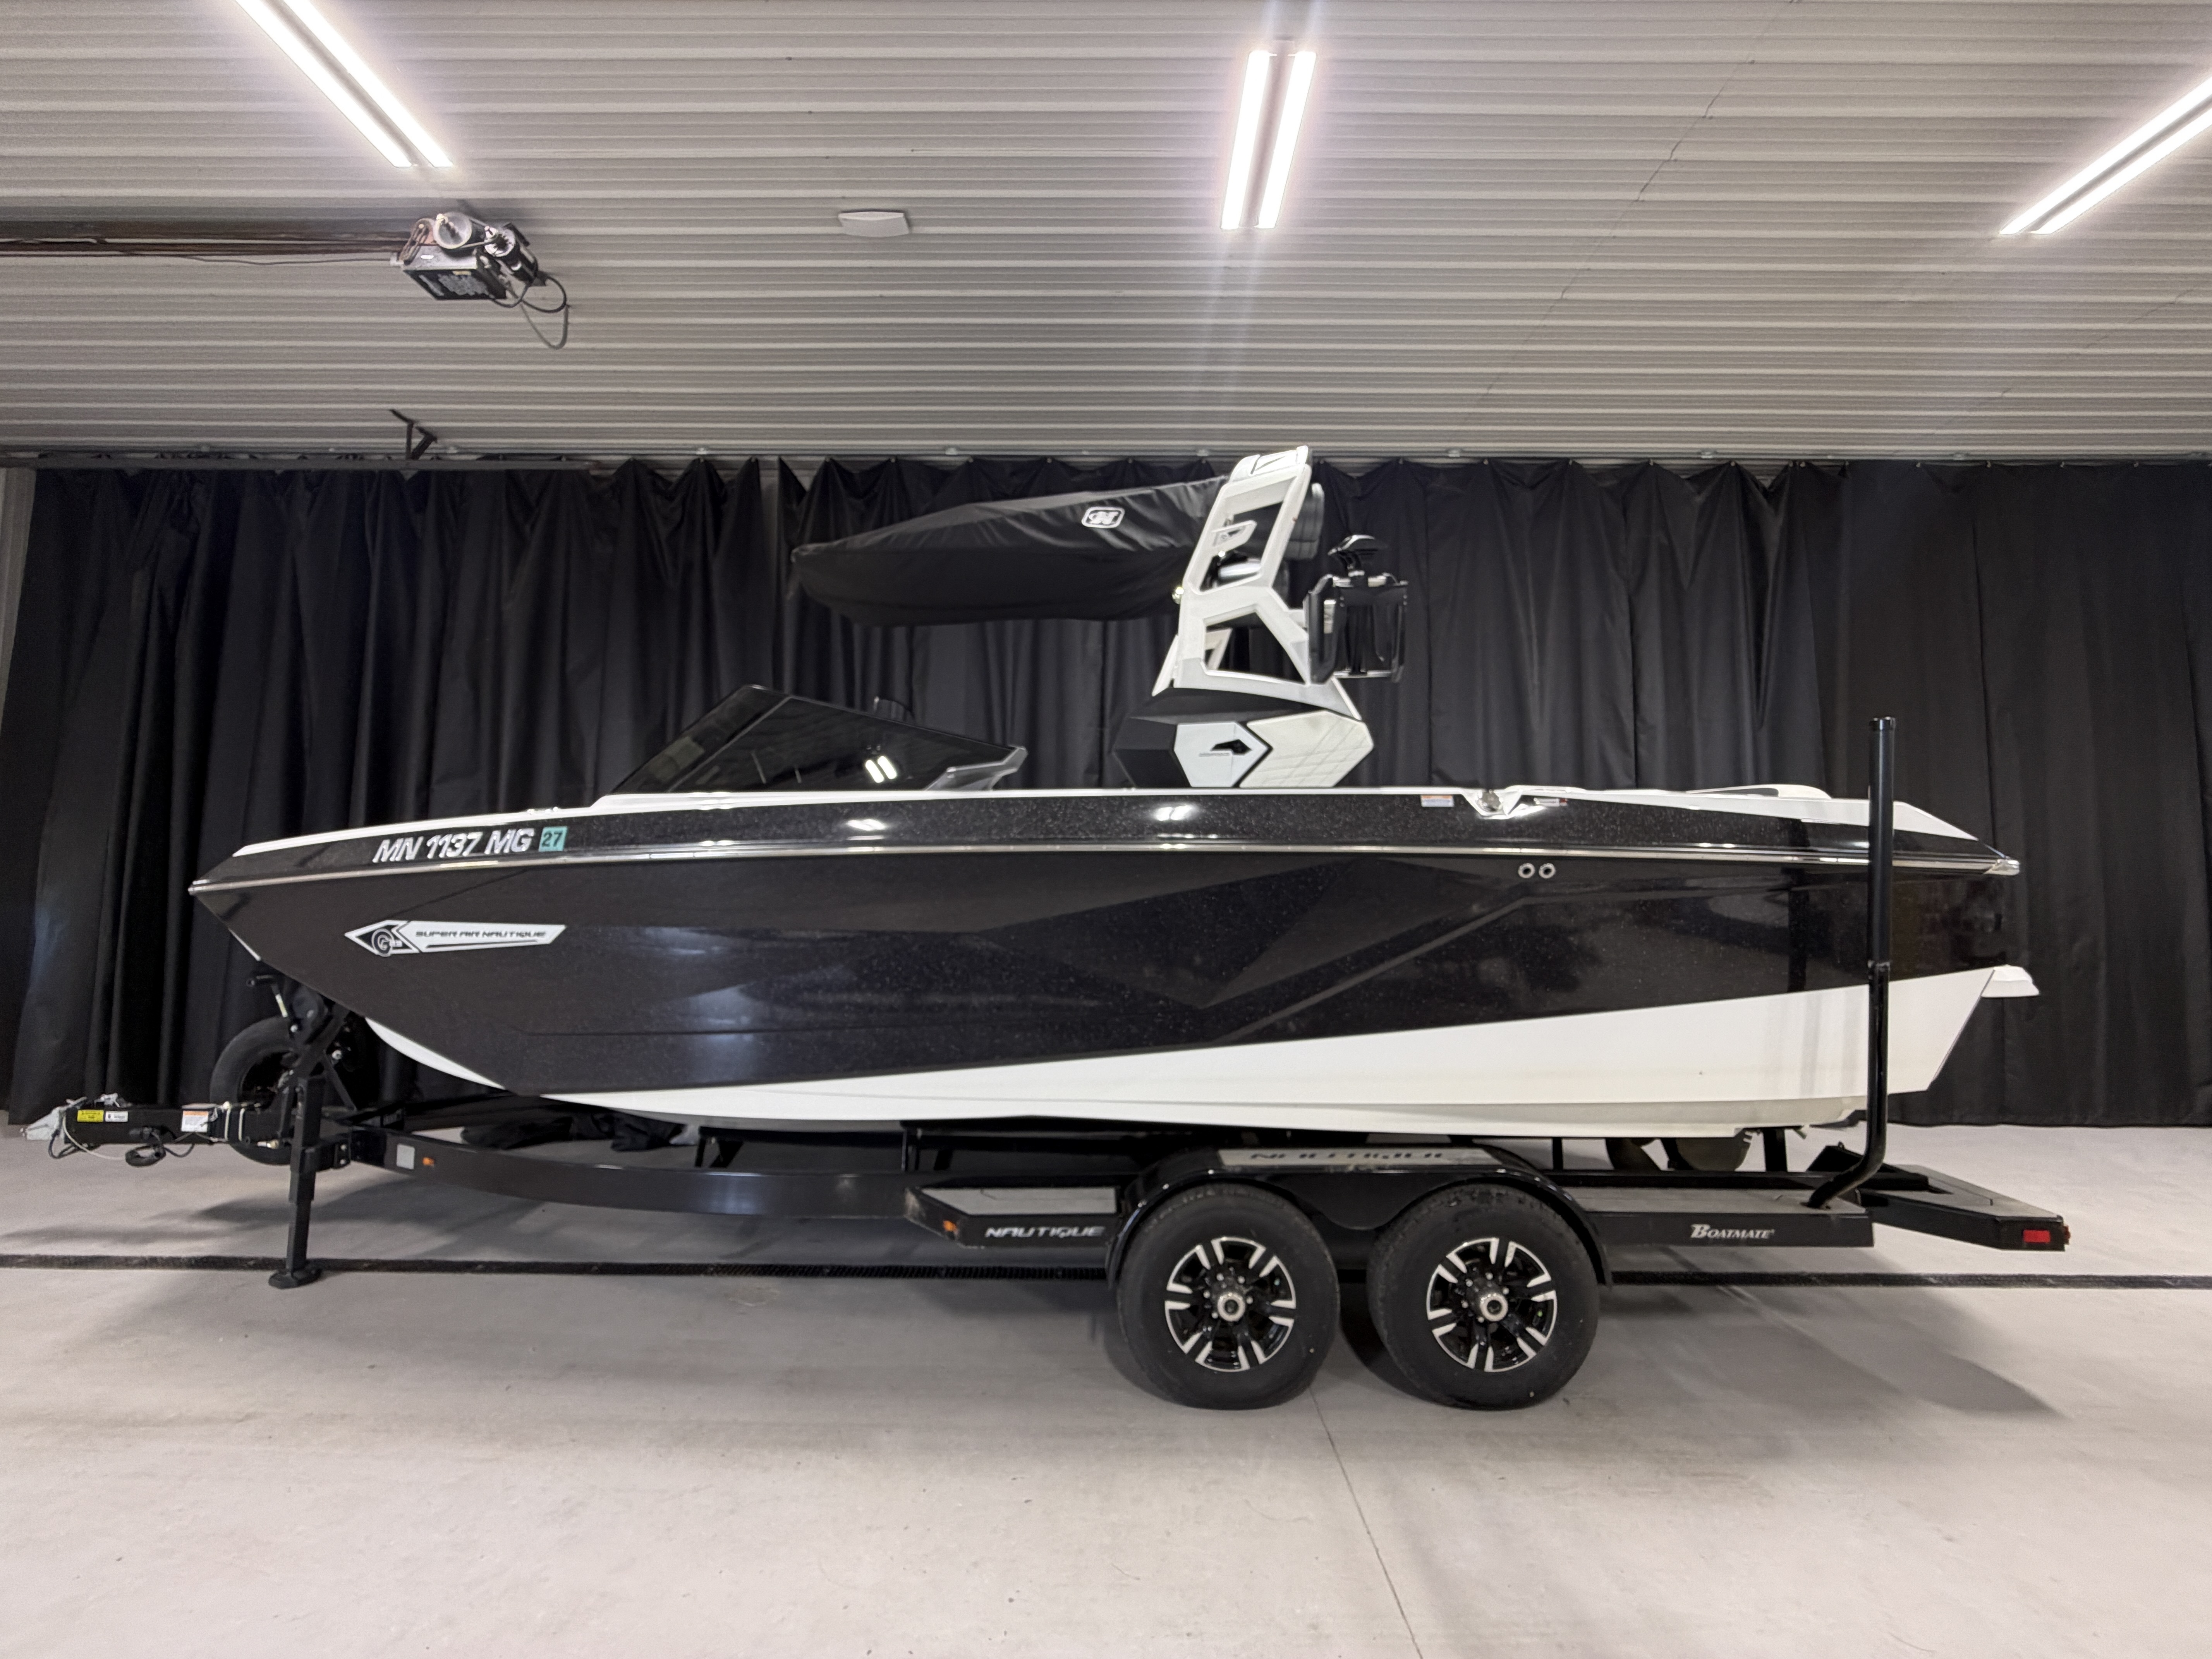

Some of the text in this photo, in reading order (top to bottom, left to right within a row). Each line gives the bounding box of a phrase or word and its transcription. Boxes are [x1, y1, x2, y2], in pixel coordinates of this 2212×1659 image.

[372, 828, 535, 863] MN 1137 MG
[541, 831, 563, 847] 27
[984, 1225, 1106, 1239] NAUTIQUE
